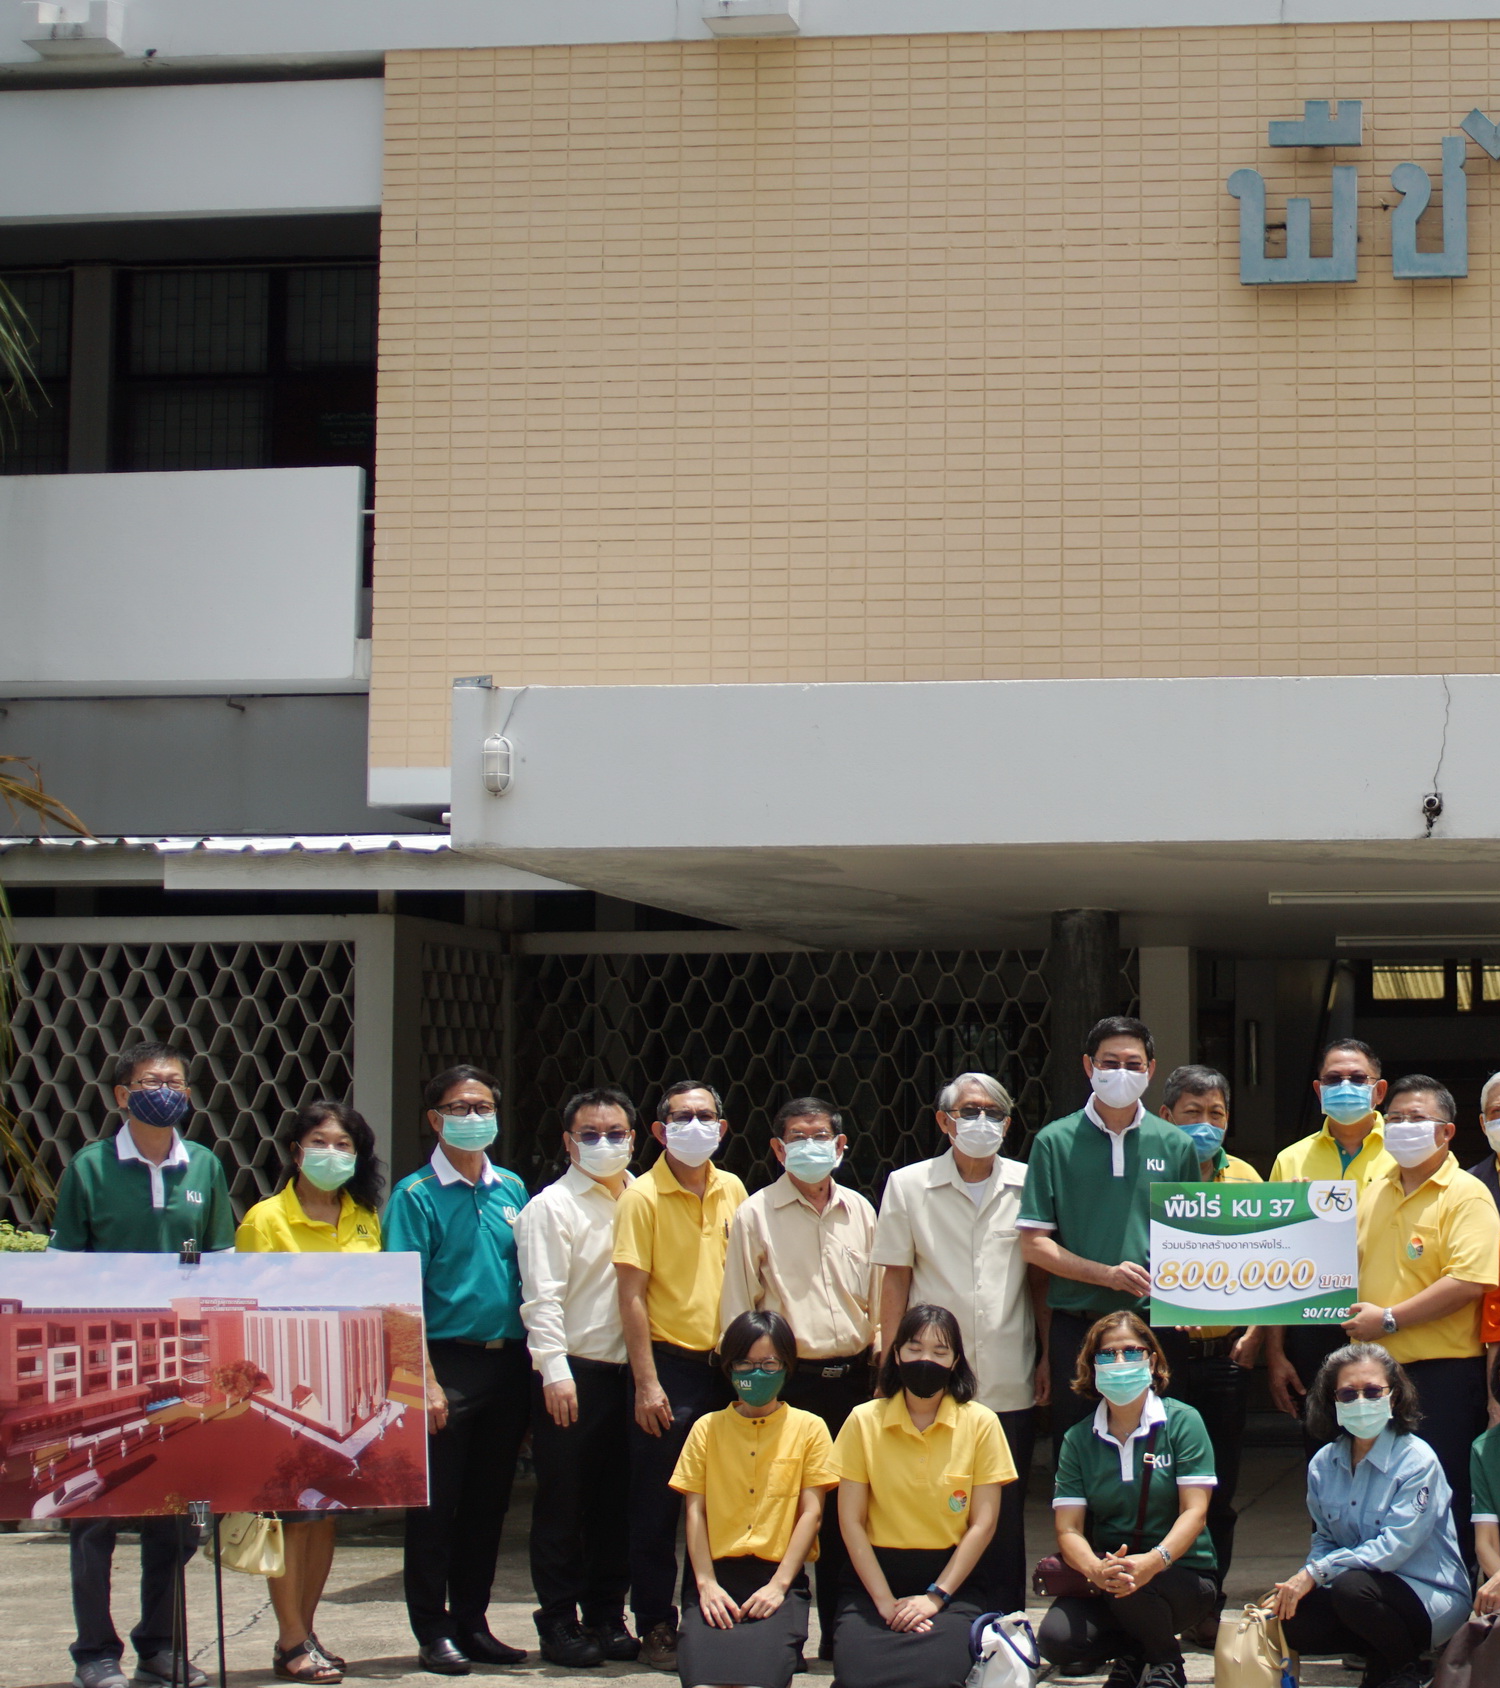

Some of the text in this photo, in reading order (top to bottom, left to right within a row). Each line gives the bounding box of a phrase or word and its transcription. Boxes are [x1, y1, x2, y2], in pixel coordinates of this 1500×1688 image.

[1146, 1158, 1165, 1171] KU
[186, 1189, 203, 1203] KU
[1164, 1192, 1295, 1217] พืชไร่ KU 37
[356, 1224, 368, 1235] KU
[1154, 1257, 1352, 1295] 800,000 บาท
[740, 1379, 752, 1388] KU
[1153, 1453, 1172, 1469] KU
